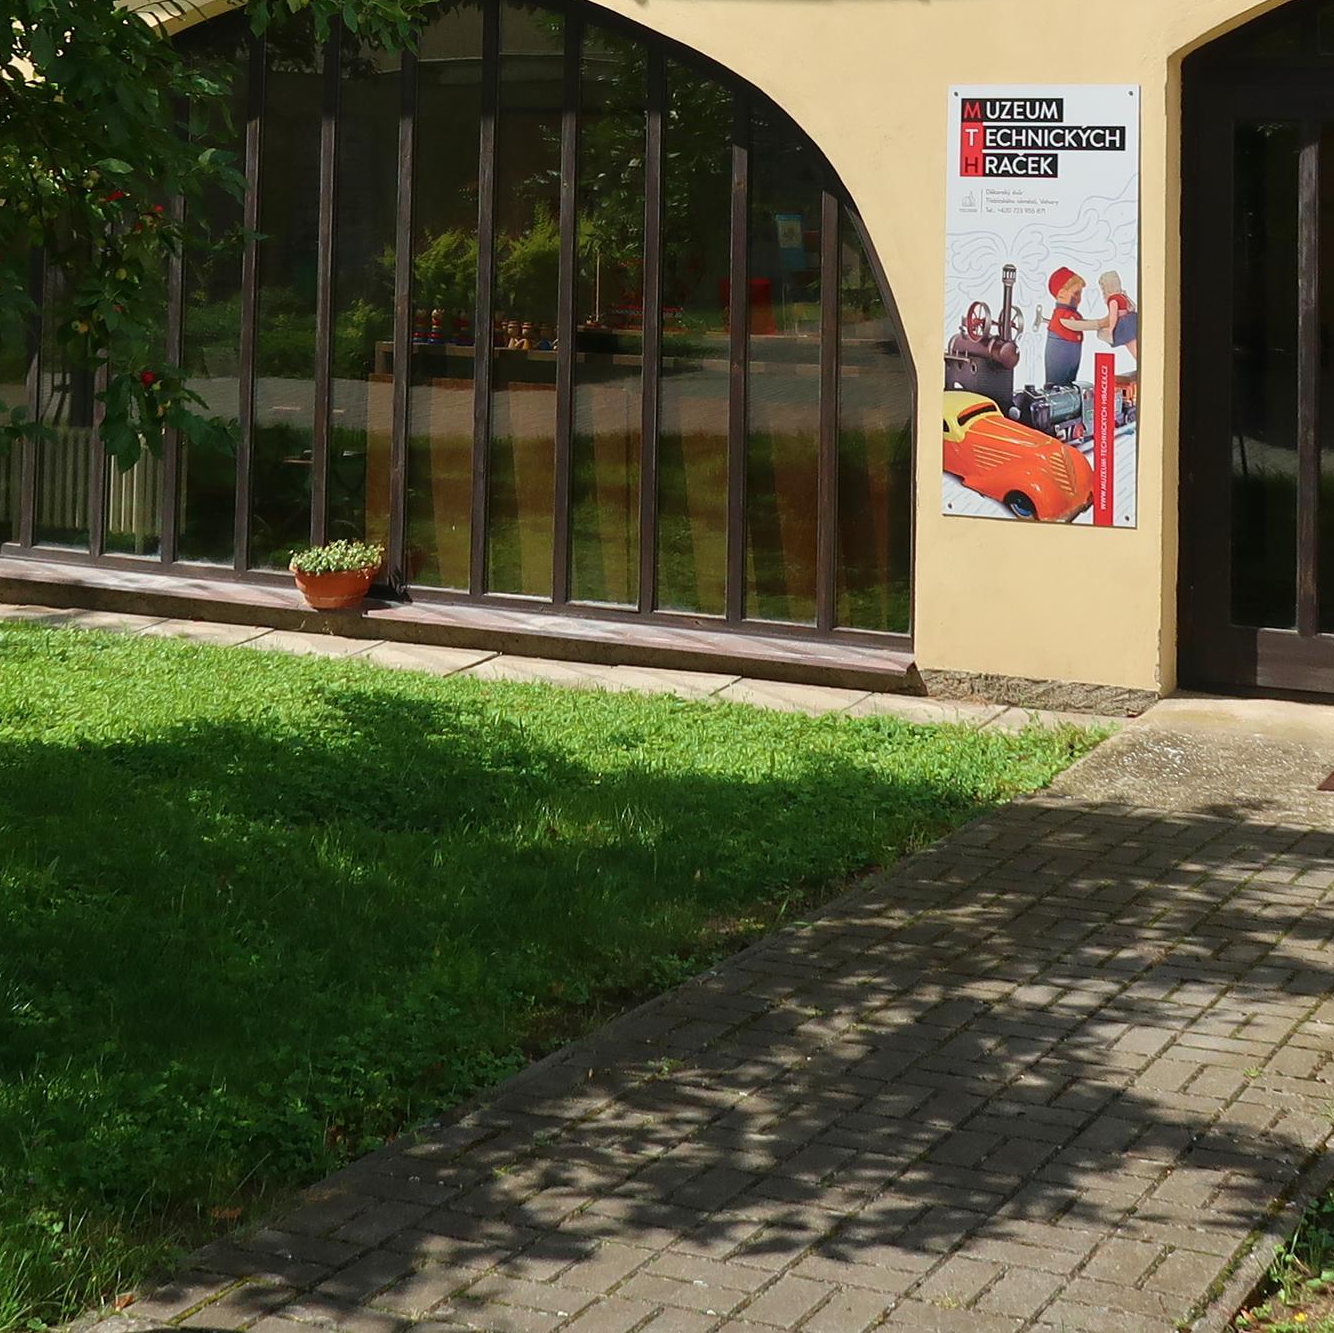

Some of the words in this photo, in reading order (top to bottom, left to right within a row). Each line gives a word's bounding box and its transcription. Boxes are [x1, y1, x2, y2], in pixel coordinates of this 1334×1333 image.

[963, 101, 1059, 120] MUZEUM
[965, 125, 1121, 149] TECHNICKÝCH
[964, 153, 1054, 175] HRAČEK
